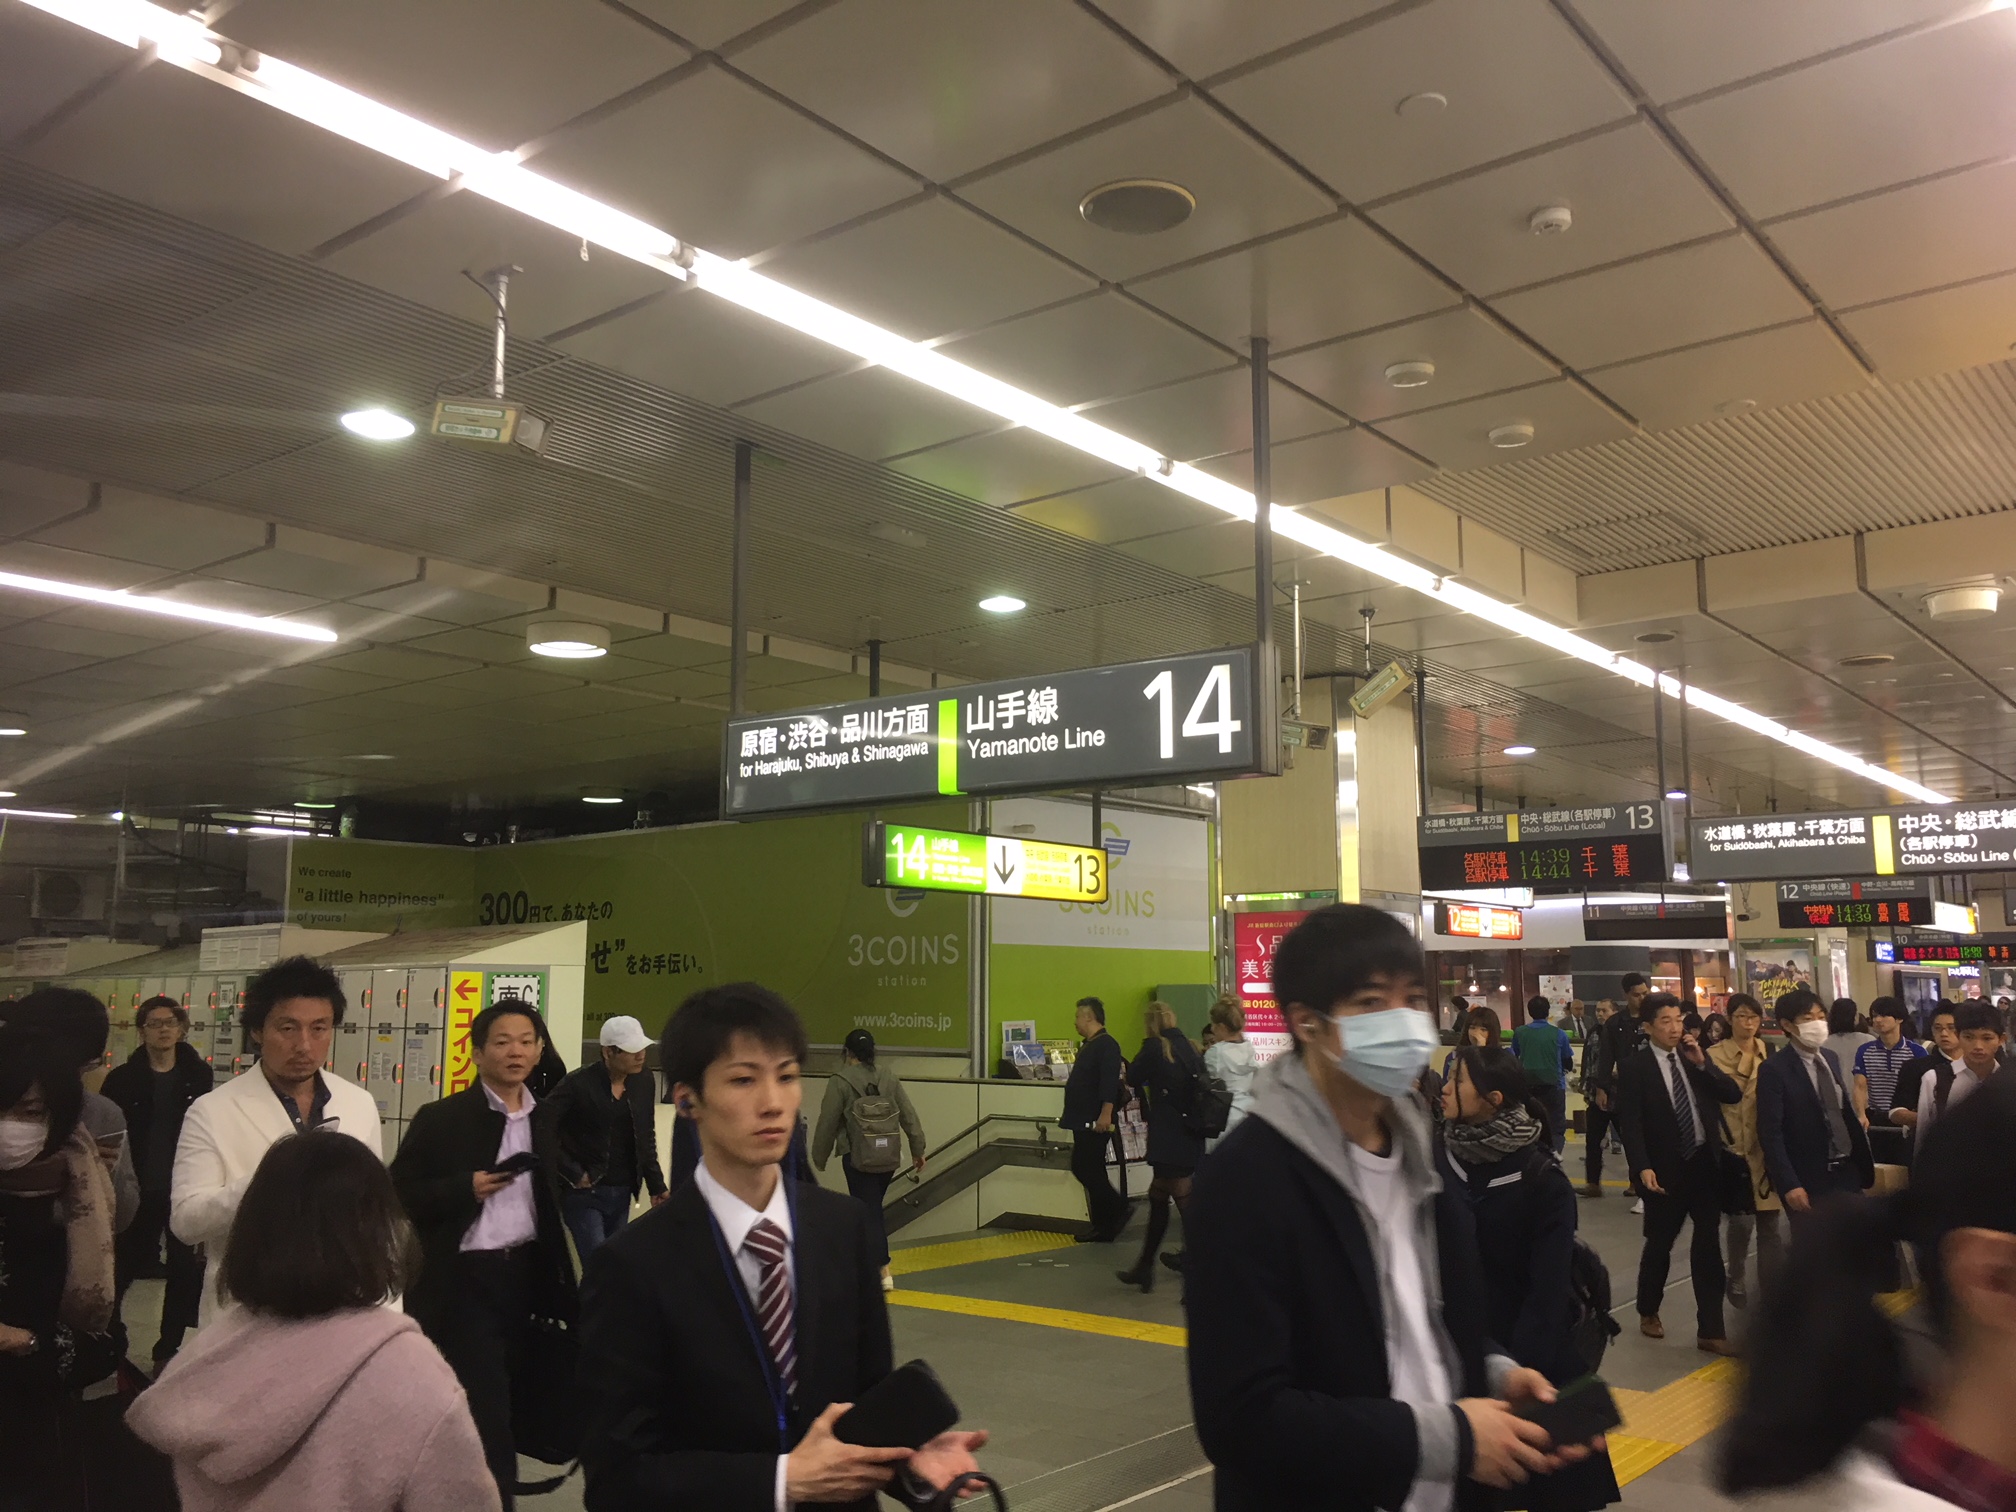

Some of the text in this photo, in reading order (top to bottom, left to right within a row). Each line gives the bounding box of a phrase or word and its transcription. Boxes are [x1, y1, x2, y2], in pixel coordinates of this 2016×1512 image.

[966, 686, 1059, 733] 山手線
[1143, 664, 1242, 759] 14
[740, 704, 929, 758] 原宿・渋谷・品川方面
[967, 727, 1106, 759] Yamanote Line
[740, 742, 929, 777] for Harajuku, Shibuya & Shinagawa
[1564, 823, 1580, 831] Line
[1581, 821, 1606, 831] (Local)
[1625, 805, 1654, 830] 13
[1704, 817, 1865, 842] 水道橋・秋葉原・千葉方面
[1710, 842, 1722, 852] for
[1778, 837, 1825, 848] Akihabara
[1827, 836, 1835, 846] &
[1836, 835, 1866, 845] Chiba
[1900, 834, 1978, 851] (各駅停車)
[891, 833, 929, 880] 14
[1464, 851, 1508, 869] 各駅停車
[1519, 848, 1571, 864] 14:39
[1981, 850, 2010, 862] Line
[298, 866, 352, 878] We create
[1074, 854, 1101, 894] 13
[1465, 867, 1510, 883] 各駅停車
[1521, 863, 1572, 880] 14:44
[318, 887, 353, 904] little
[358, 890, 445, 908] happiness"
[1780, 884, 1799, 899] 12
[296, 912, 347, 924] of yours!
[1587, 906, 1600, 918] 11
[1836, 904, 1871, 914] 14:37
[1837, 913, 1872, 922] 14:39
[1448, 908, 1461, 931] 12
[1087, 924, 1130, 936] station
[1896, 935, 1908, 944] 10
[848, 933, 960, 966] 3COINS
[877, 974, 927, 986] station
[854, 1012, 952, 1032] www.3coins.jp
